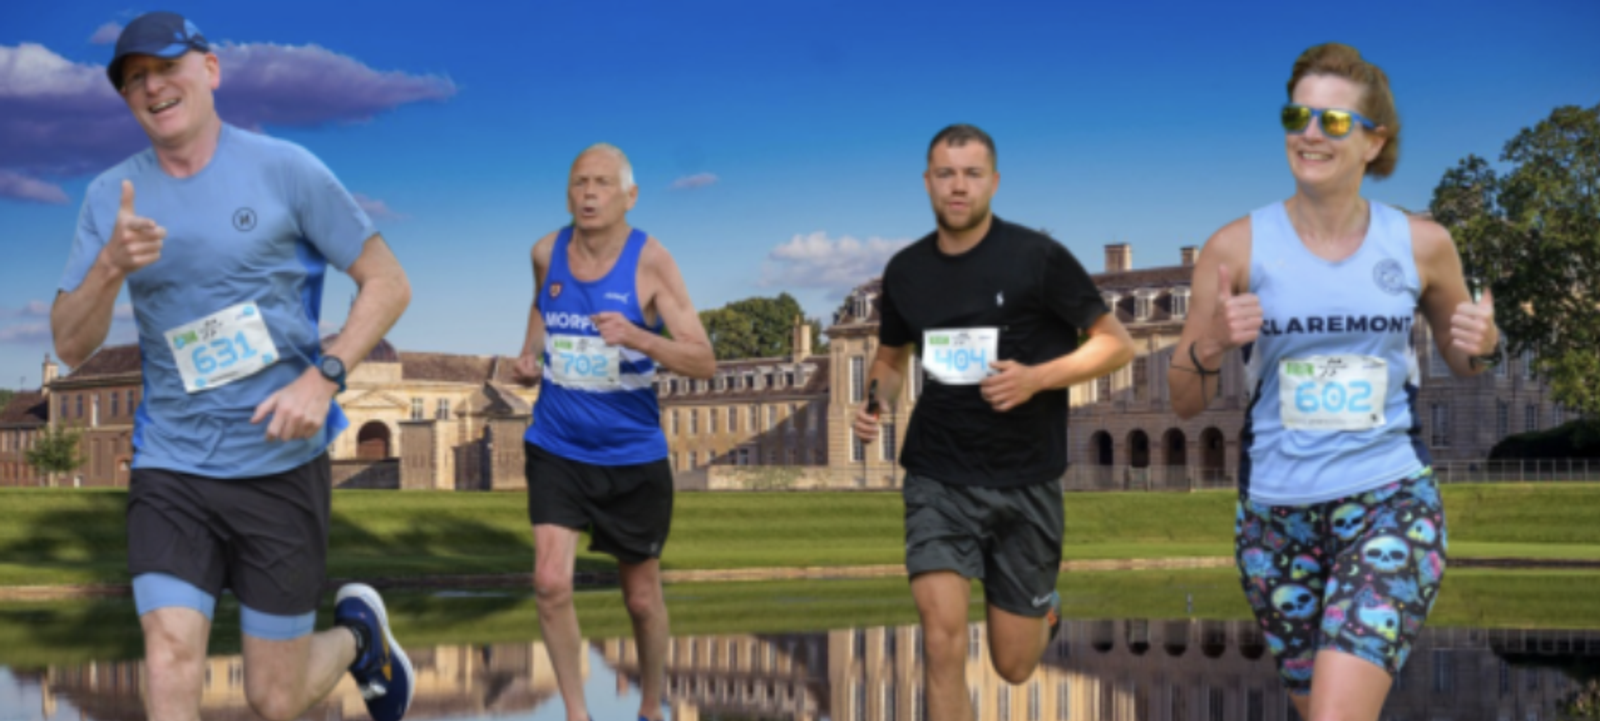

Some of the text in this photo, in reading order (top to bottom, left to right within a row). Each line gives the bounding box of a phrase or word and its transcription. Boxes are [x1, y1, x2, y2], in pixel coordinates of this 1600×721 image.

[545, 311, 599, 332] MORP
[191, 330, 258, 375] 631
[934, 347, 987, 372] 404
[560, 353, 609, 378] 702
[1294, 380, 1374, 414] 602
